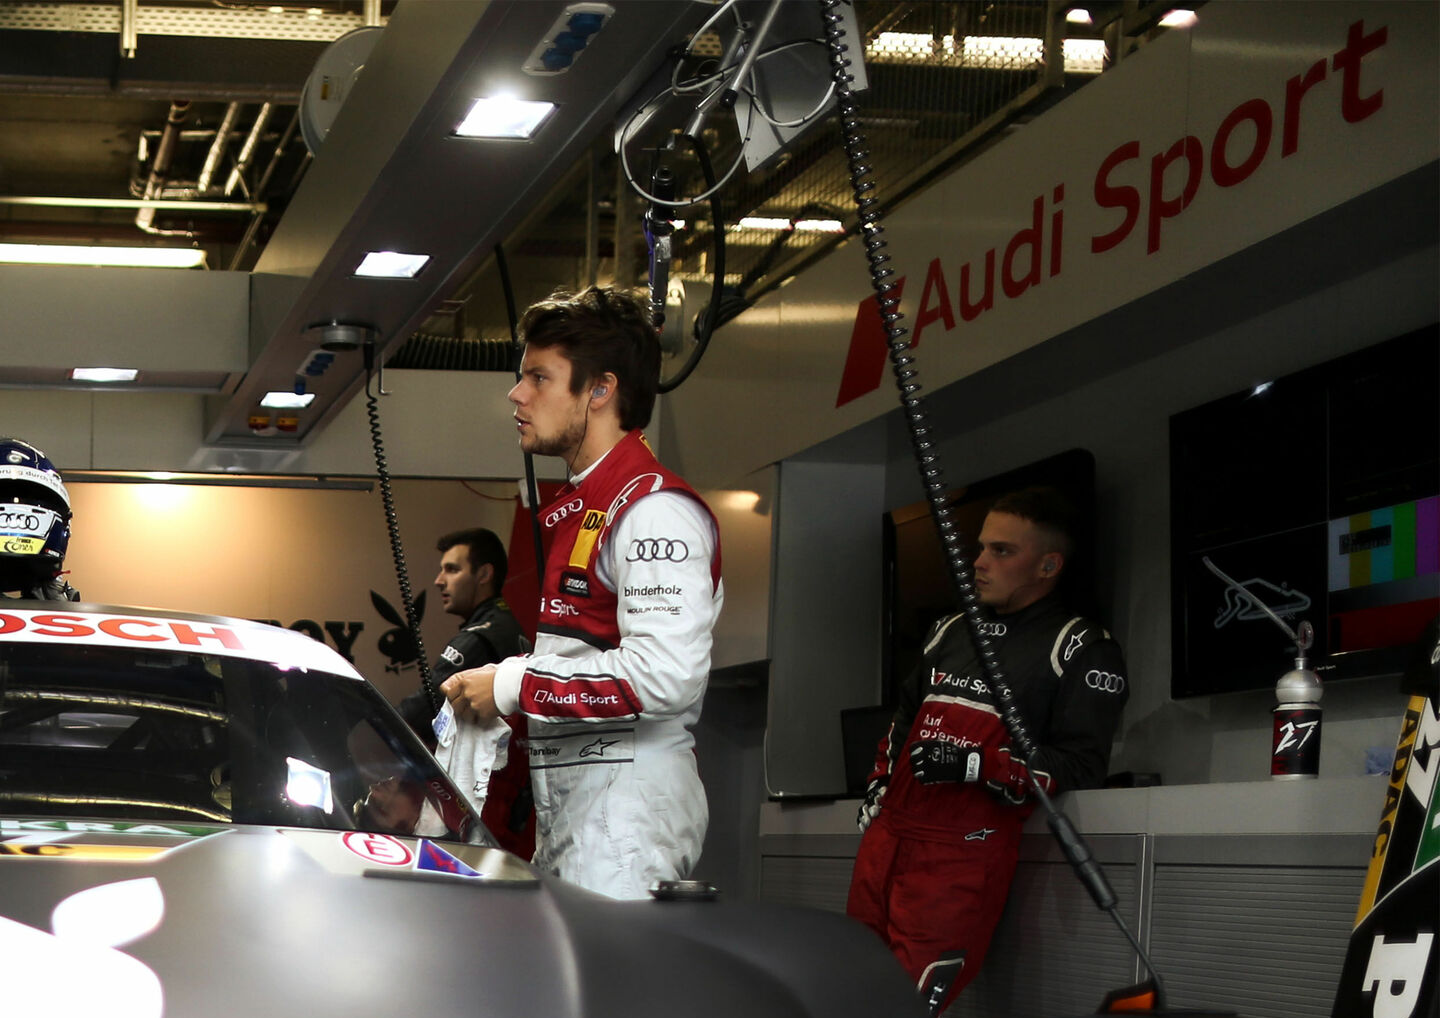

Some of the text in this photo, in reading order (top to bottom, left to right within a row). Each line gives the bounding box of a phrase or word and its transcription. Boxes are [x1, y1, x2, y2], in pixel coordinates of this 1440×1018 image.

[911, 18, 1388, 349] Audi Sport
[624, 585, 682, 597] binderholz
[546, 692, 619, 706] Audi Sport
[1274, 721, 1319, 755] 27
[1372, 709, 1419, 859] ADAC
[364, 839, 394, 859] E
